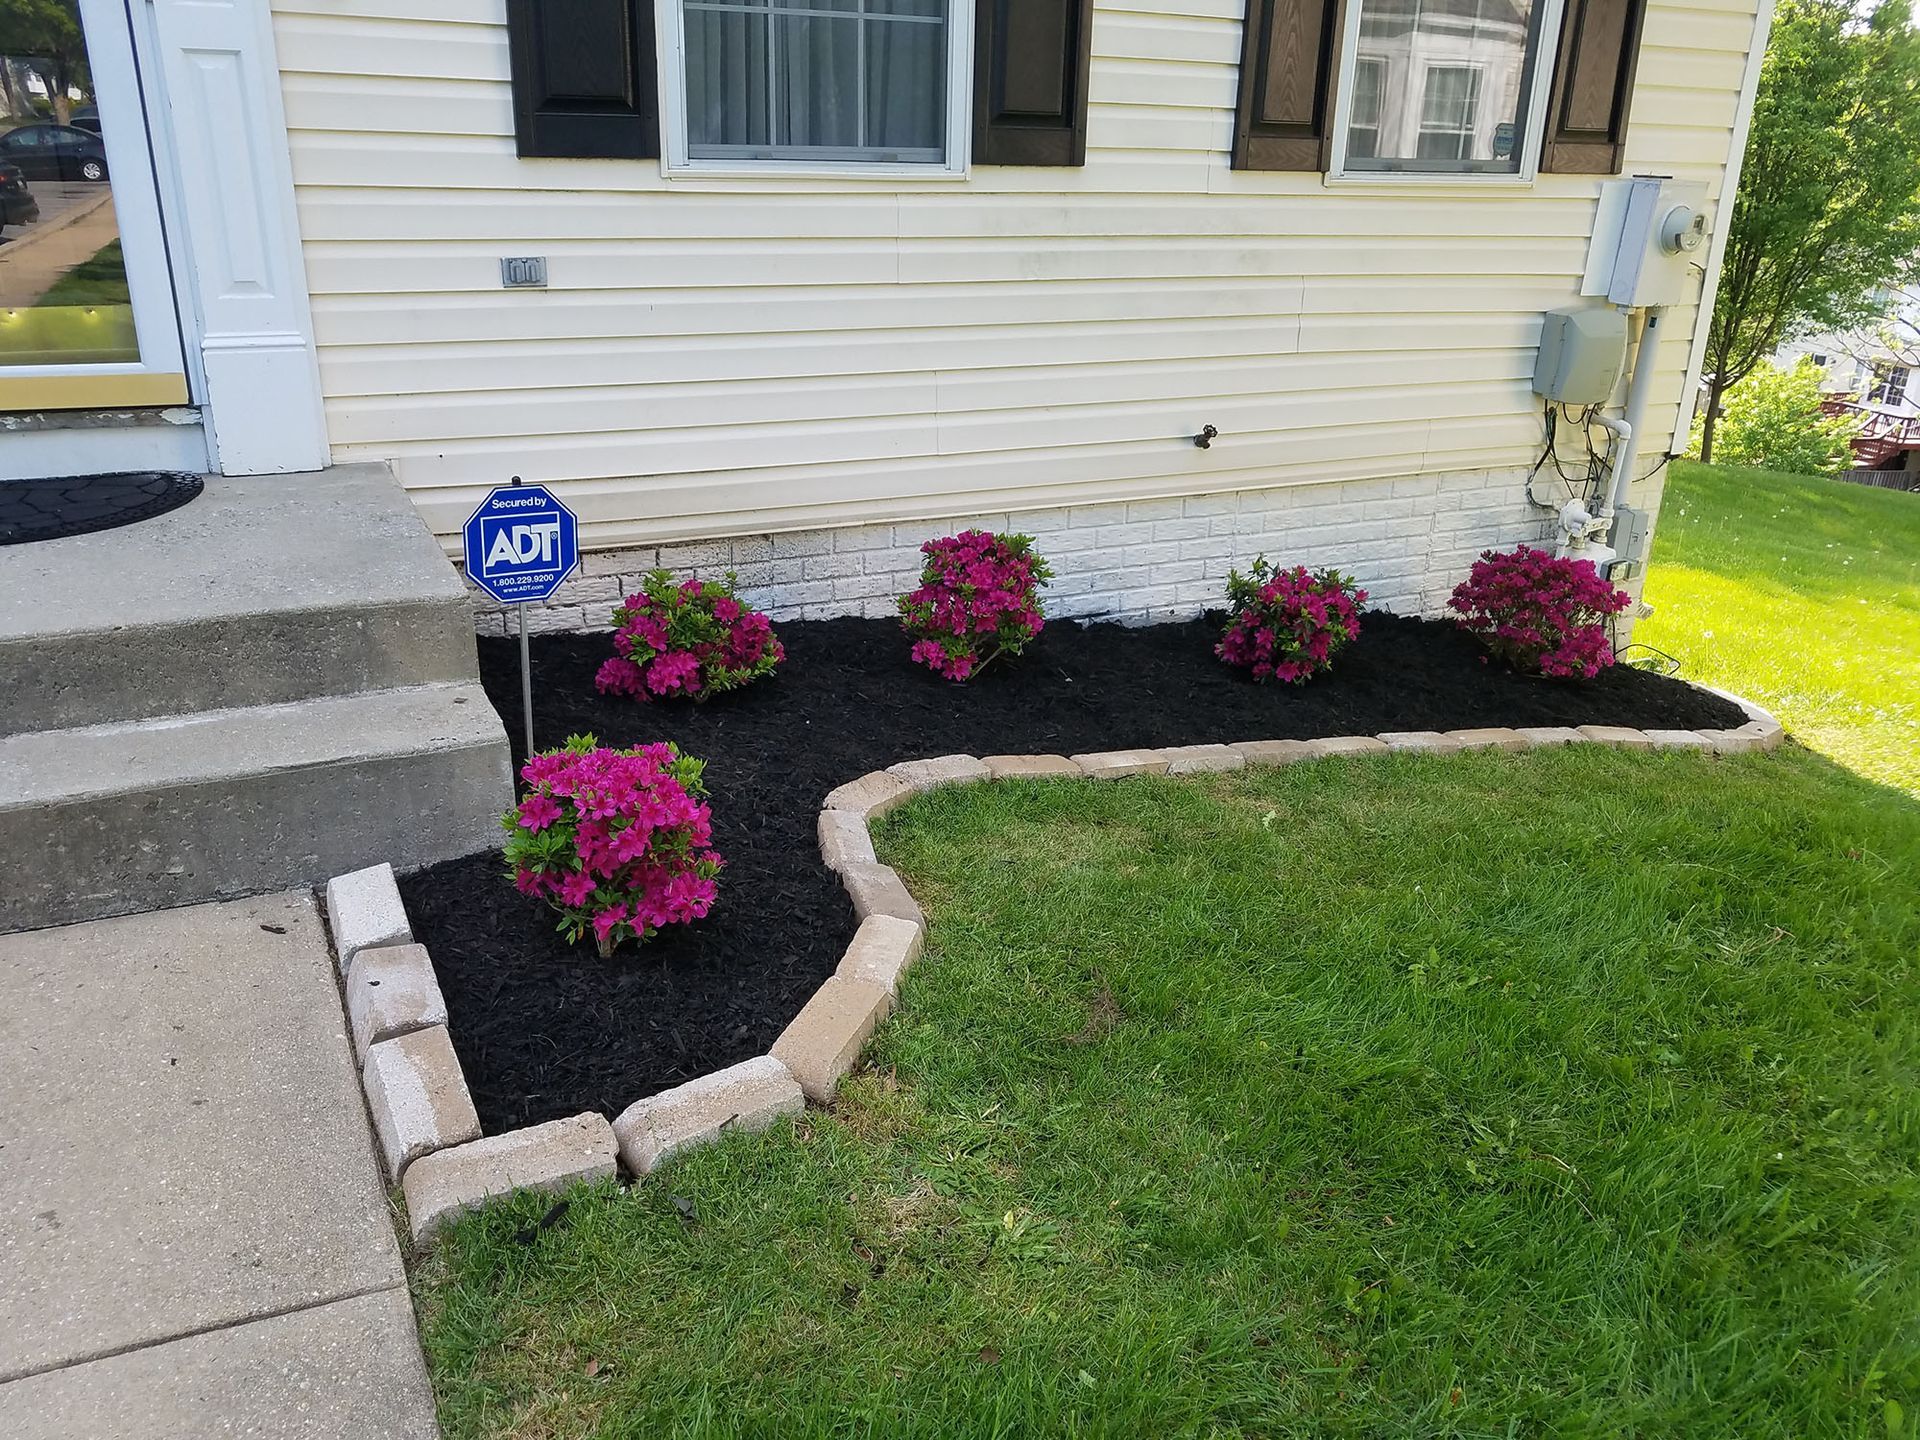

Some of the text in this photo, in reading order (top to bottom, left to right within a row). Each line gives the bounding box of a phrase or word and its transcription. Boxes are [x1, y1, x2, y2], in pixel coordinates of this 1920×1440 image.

[492, 496, 547, 509] Secured by
[485, 523, 558, 567] ADT
[492, 573, 554, 587] 1.800.229.9200
[503, 585, 544, 593] www.ADT.com
